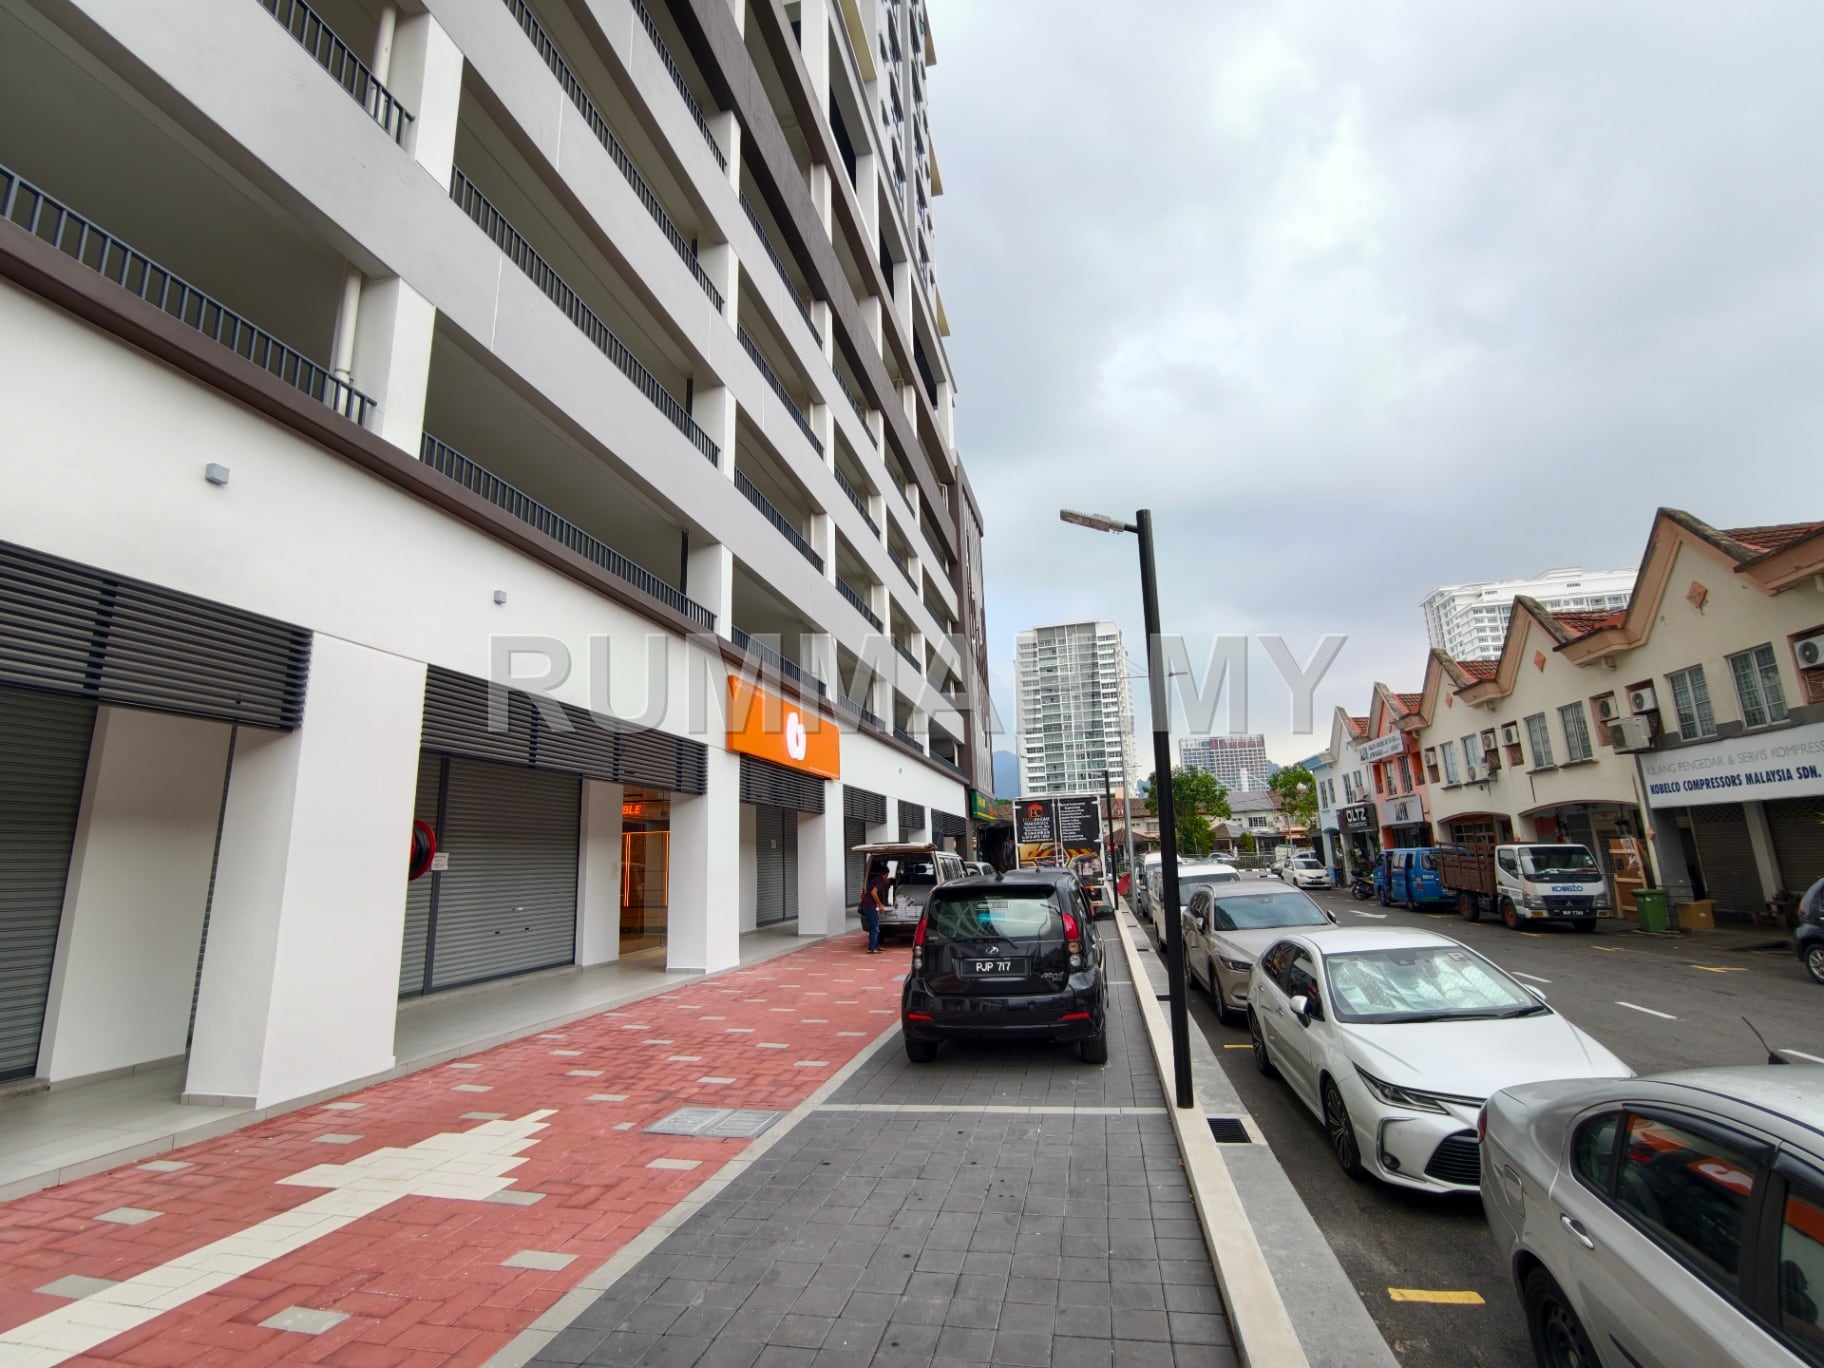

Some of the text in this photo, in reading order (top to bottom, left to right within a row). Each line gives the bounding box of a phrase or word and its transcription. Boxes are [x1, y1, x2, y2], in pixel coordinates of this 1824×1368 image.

[1677, 756, 1724, 772] PENGEDAR
[1727, 756, 1735, 766] &
[1737, 749, 1768, 764] SERVIS
[1650, 765, 1822, 795] KOBELCO COMPRESSORS MALAYSIA SDN.
[975, 961, 1012, 973] PJP 717
